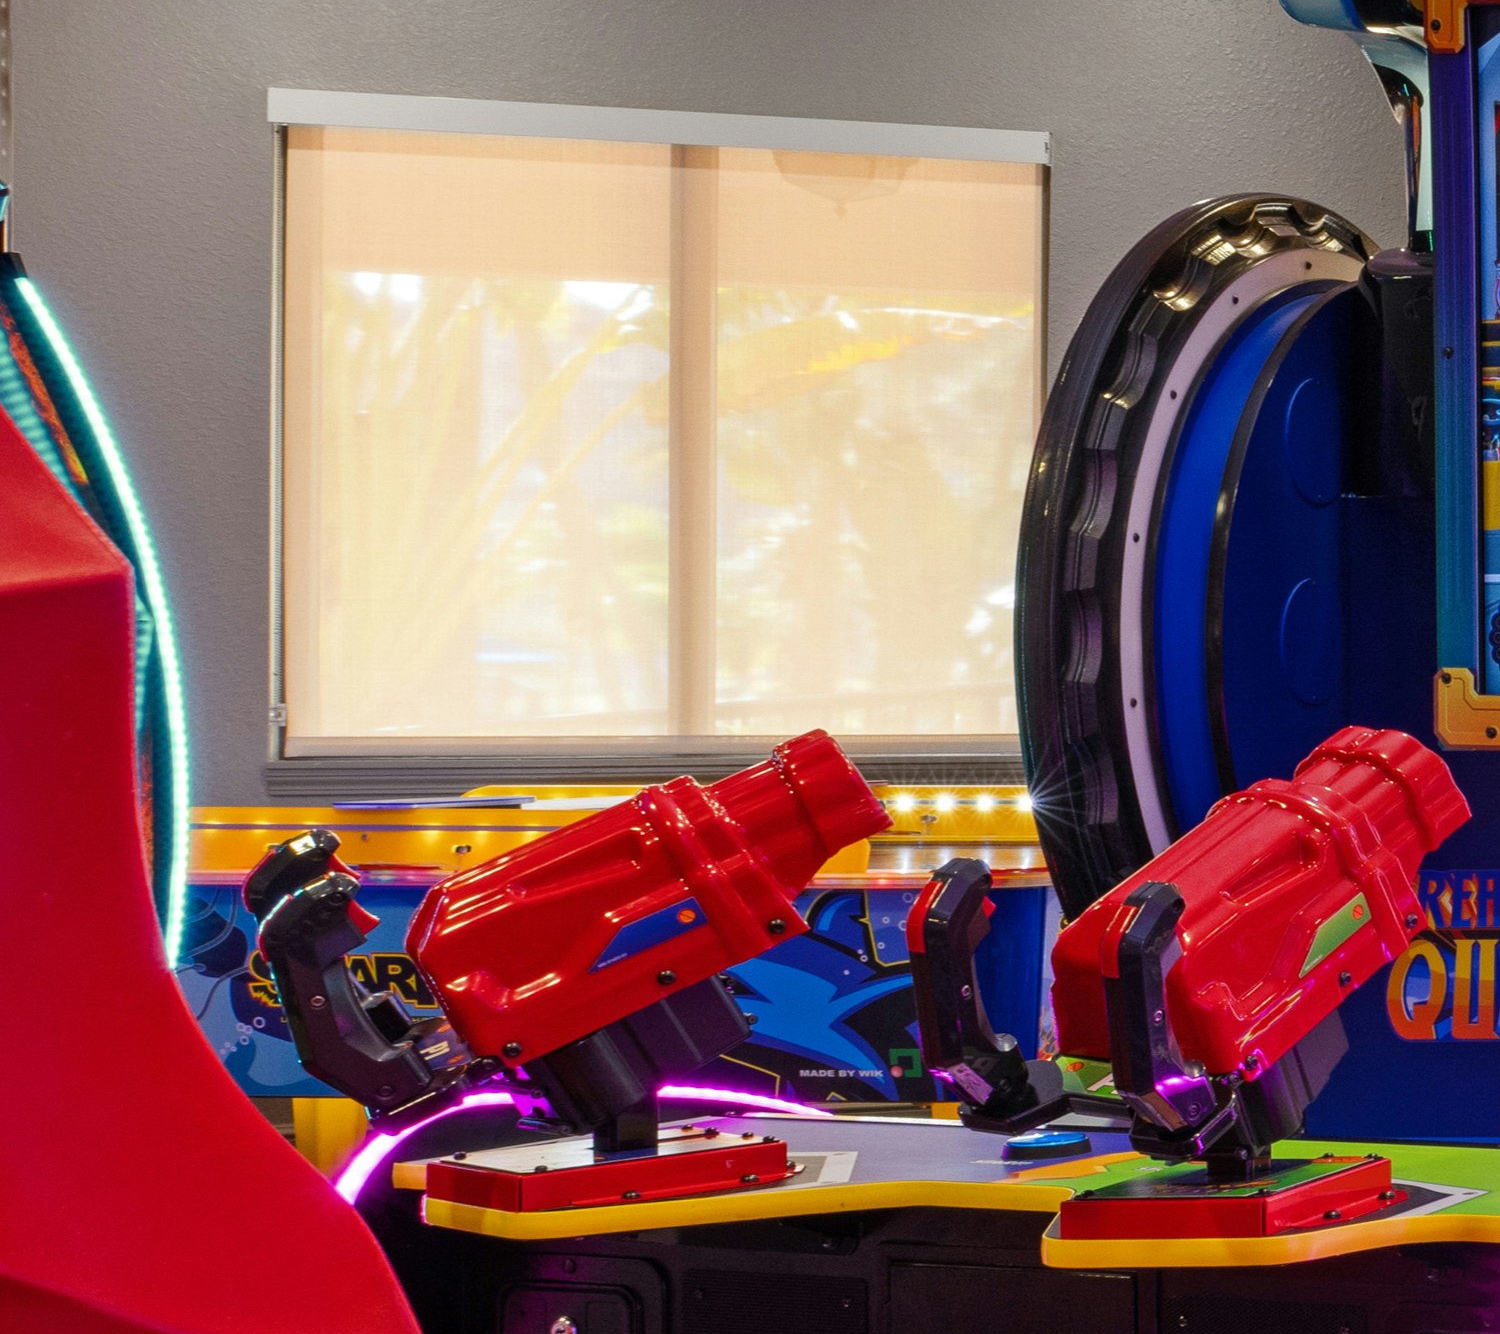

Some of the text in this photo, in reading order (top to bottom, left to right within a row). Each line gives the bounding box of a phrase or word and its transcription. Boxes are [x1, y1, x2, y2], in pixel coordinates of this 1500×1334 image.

[800, 1069, 884, 1077] MADE BY WIK
